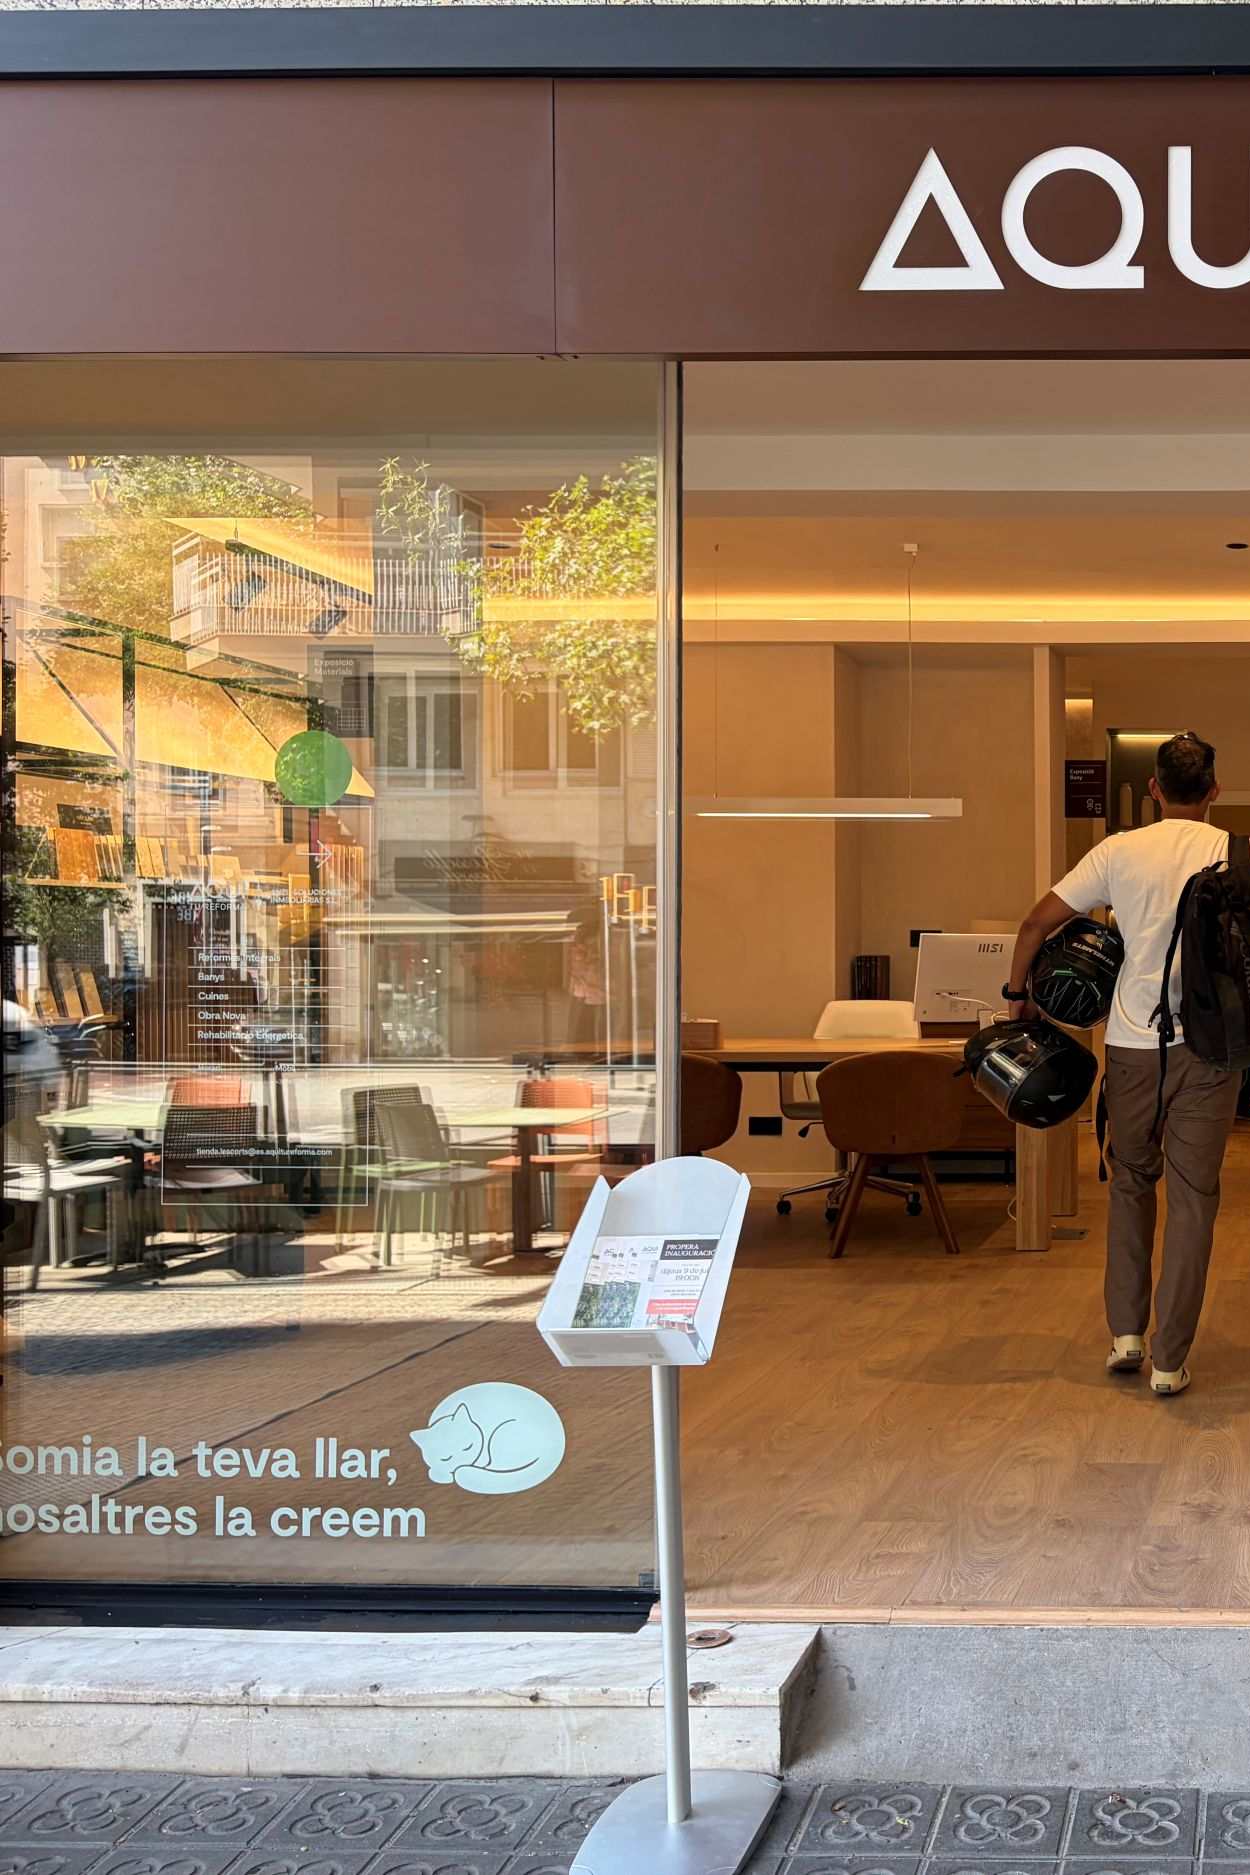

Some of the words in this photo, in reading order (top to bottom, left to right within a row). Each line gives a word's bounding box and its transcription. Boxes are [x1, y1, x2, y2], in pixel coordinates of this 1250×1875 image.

[198, 972, 225, 983] Banys
[198, 991, 229, 1001] Cuines
[198, 1011, 221, 1020] Obra
[222, 1011, 247, 1020] Nova
[137, 1436, 179, 1477] la
[191, 1441, 301, 1479] teva
[315, 1437, 398, 1486] llar,
[215, 1495, 257, 1537] la
[270, 1507, 427, 1539] creem
